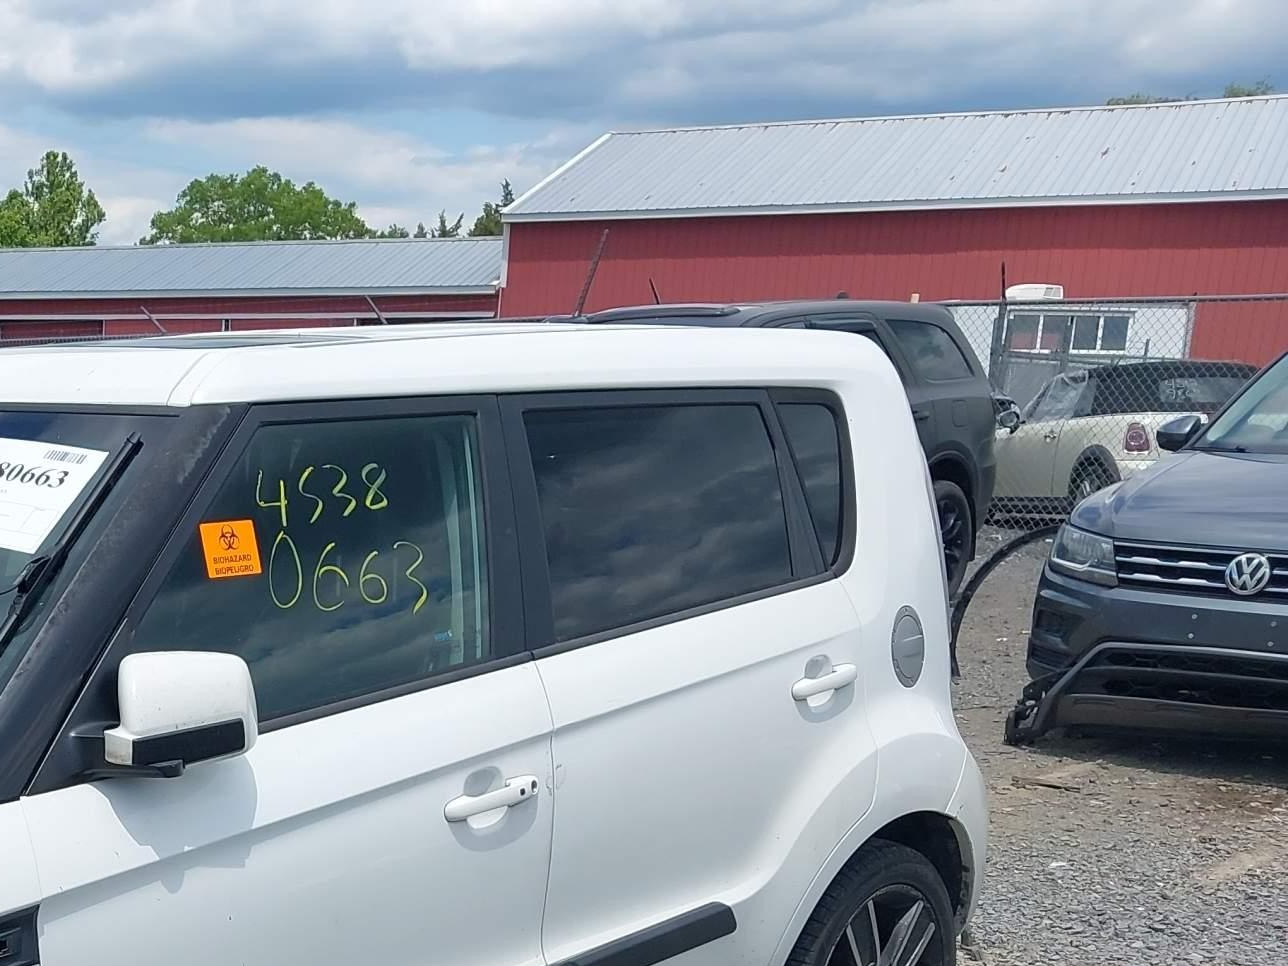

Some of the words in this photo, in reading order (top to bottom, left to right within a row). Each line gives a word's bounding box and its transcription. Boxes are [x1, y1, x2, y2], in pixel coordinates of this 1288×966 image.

[255, 463, 388, 527] 4538
[213, 554, 252, 565] BIOHAZARD
[214, 564, 254, 576] BIOPELIGRO
[269, 531, 428, 615] 0663
